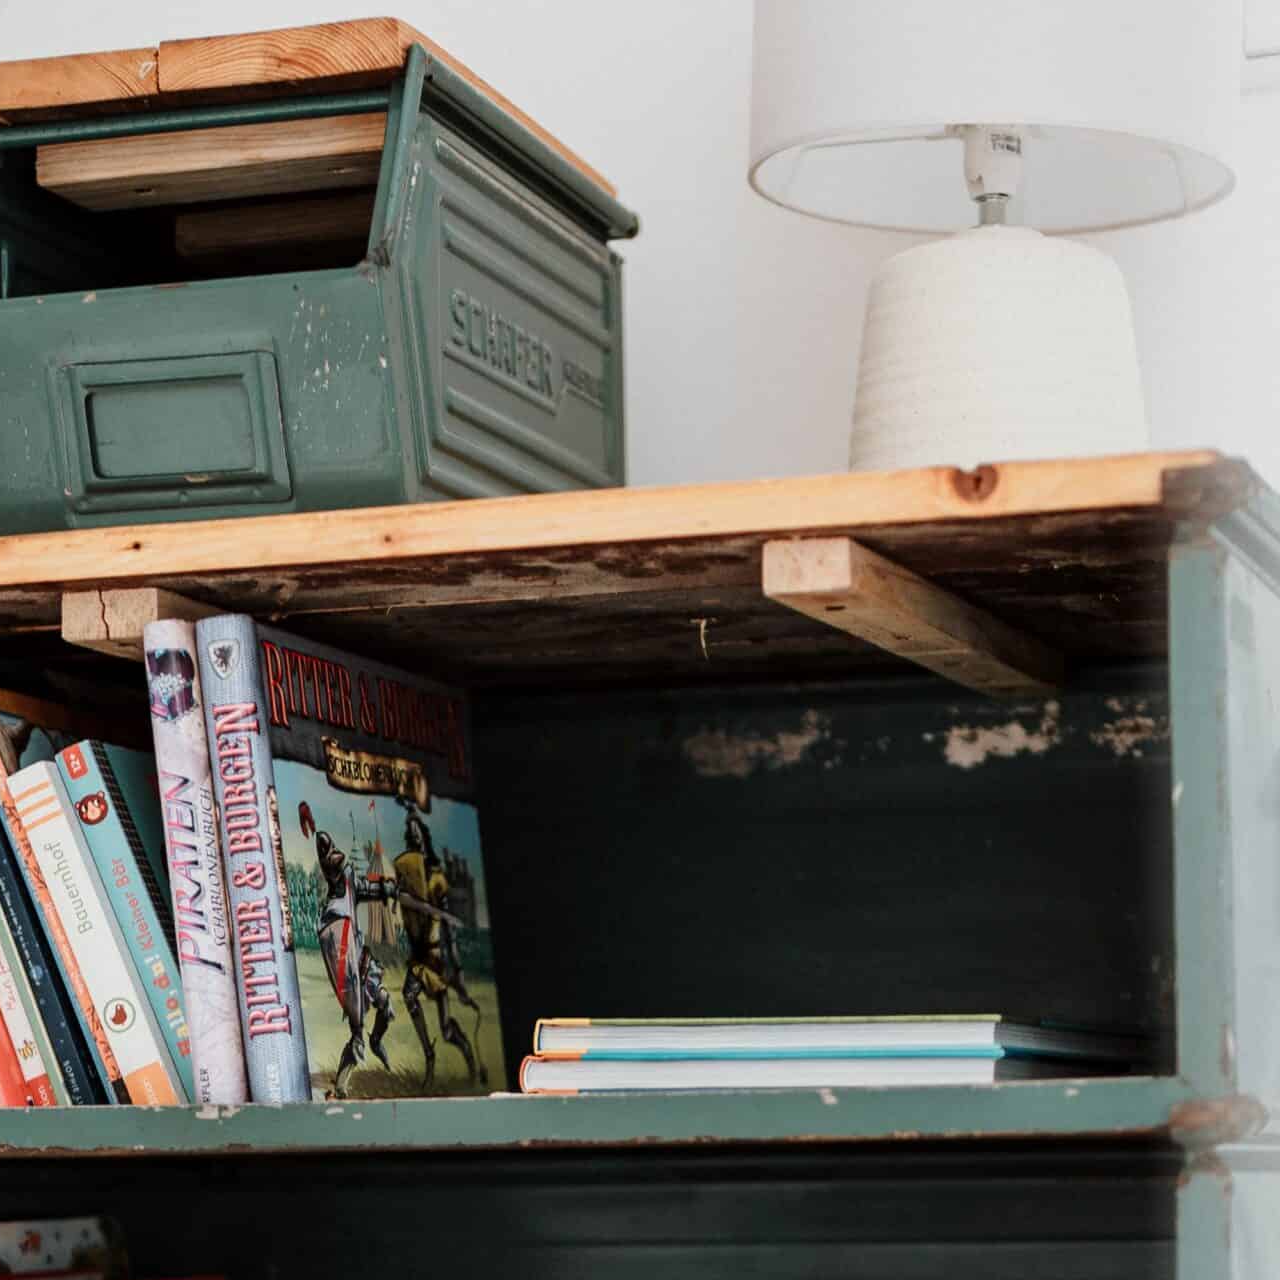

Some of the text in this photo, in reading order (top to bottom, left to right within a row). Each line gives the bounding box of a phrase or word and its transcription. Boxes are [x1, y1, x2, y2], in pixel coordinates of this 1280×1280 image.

[262, 640, 354, 728] RITTER
[358, 672, 376, 733] &
[211, 701, 262, 856] BURGEN
[43, 838, 94, 933] Bauernhof
[122, 889, 155, 951] Kleiner
[160, 769, 225, 979] PIRATEN
[198, 786, 228, 947] SCHABLONENBUCH
[229, 861, 266, 892] &
[233, 897, 291, 1038] RITTER
